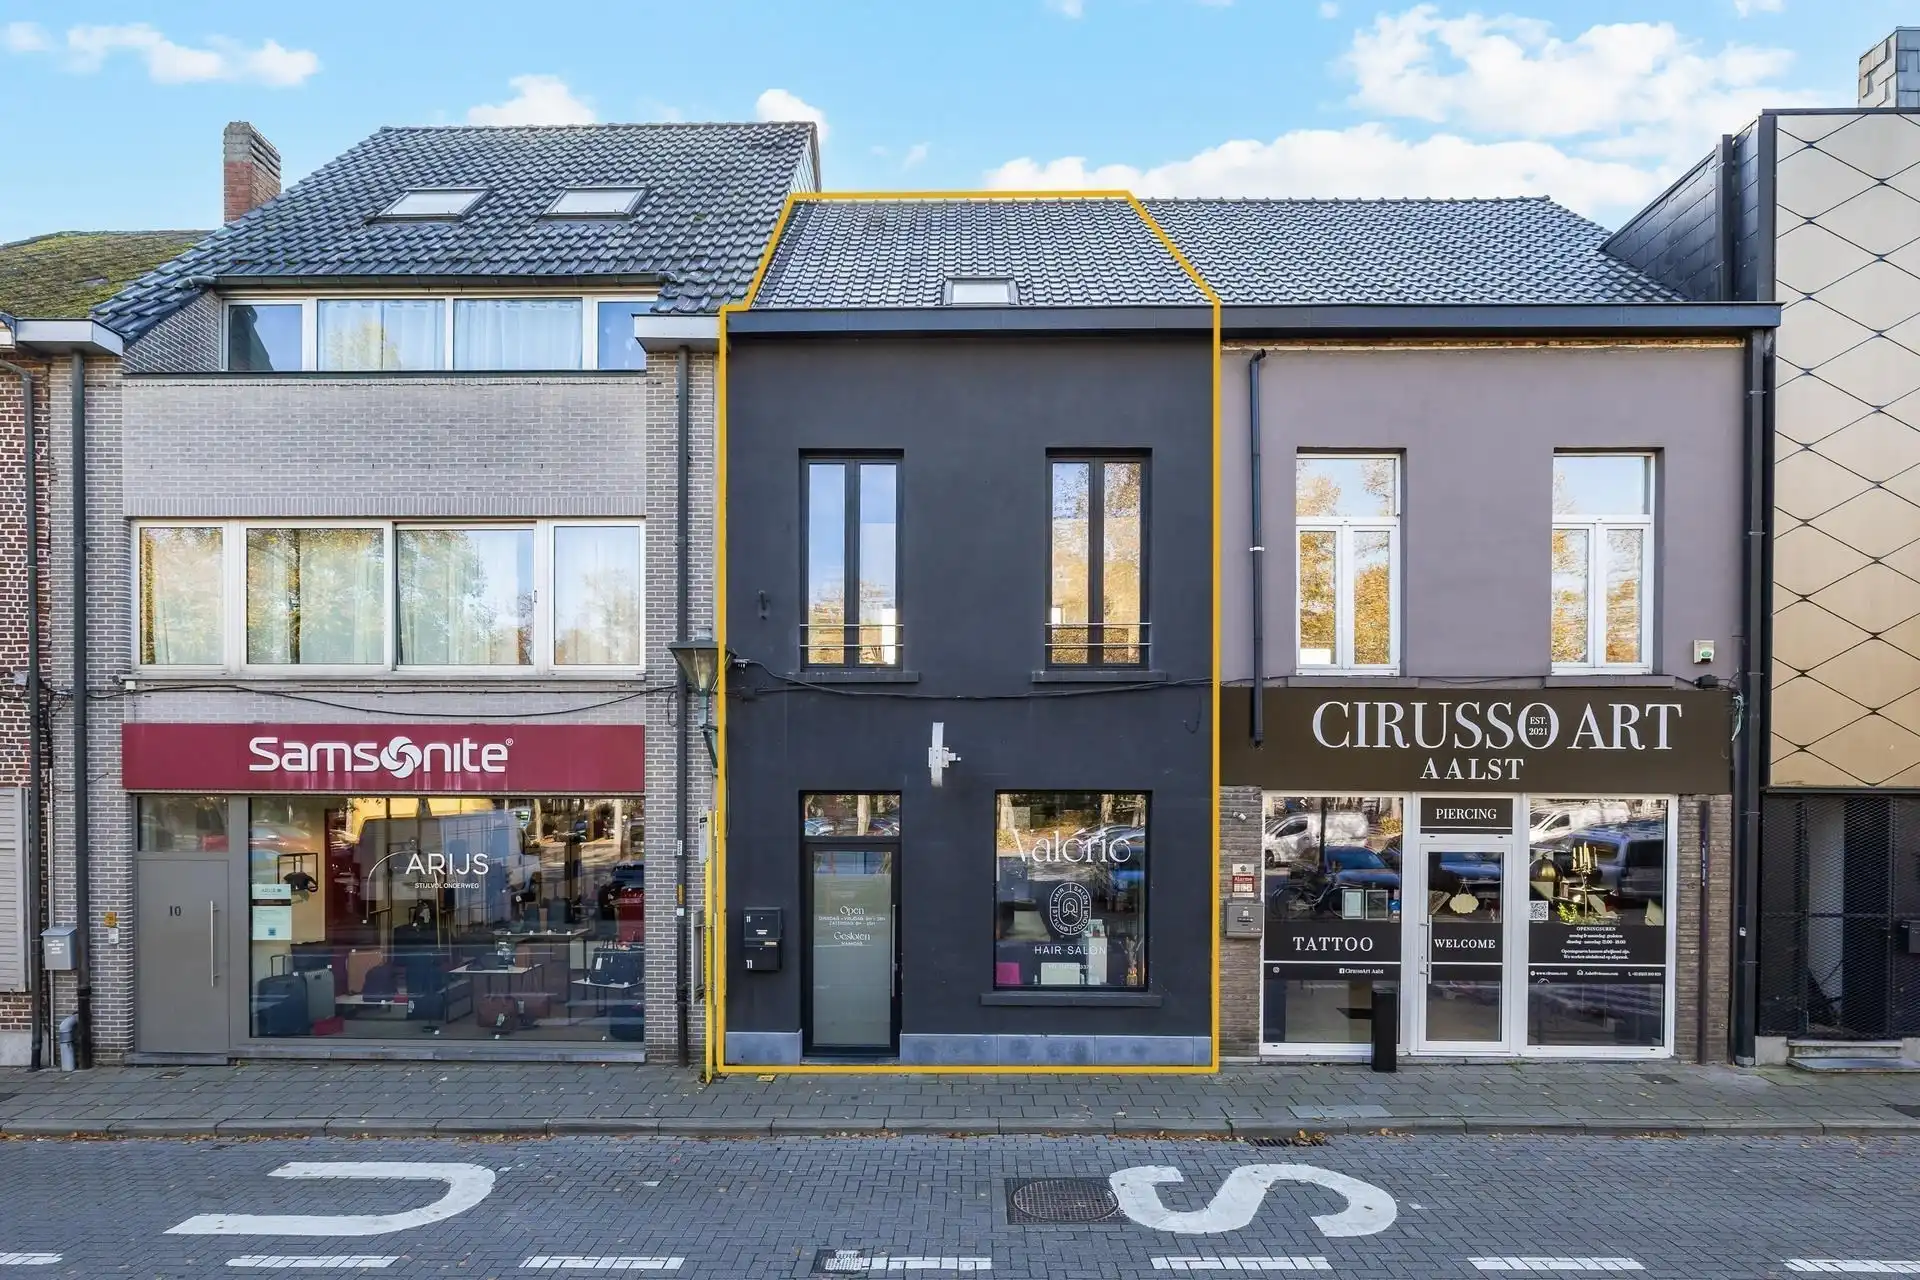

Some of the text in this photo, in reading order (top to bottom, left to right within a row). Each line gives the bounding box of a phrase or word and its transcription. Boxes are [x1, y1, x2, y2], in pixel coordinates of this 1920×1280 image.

[1312, 701, 1683, 751] CIRUSSO ART
[1529, 716, 1548, 725] EST.
[1528, 727, 1548, 736] 2021
[1420, 757, 1524, 781] AALST
[1435, 808, 1497, 820] PIERCING
[405, 853, 489, 876] ARIJS
[1053, 886, 1089, 905] HAIR SALON
[169, 905, 182, 917] 10
[840, 905, 865, 916] Open
[1052, 909, 1089, 932] STYLING COLOUR
[833, 931, 871, 941] Gesloten
[1292, 936, 1374, 952] TATTOO
[1433, 938, 1496, 949] WELCOME
[1034, 945, 1106, 955] HAIR SALON
[746, 959, 753, 969] 11
